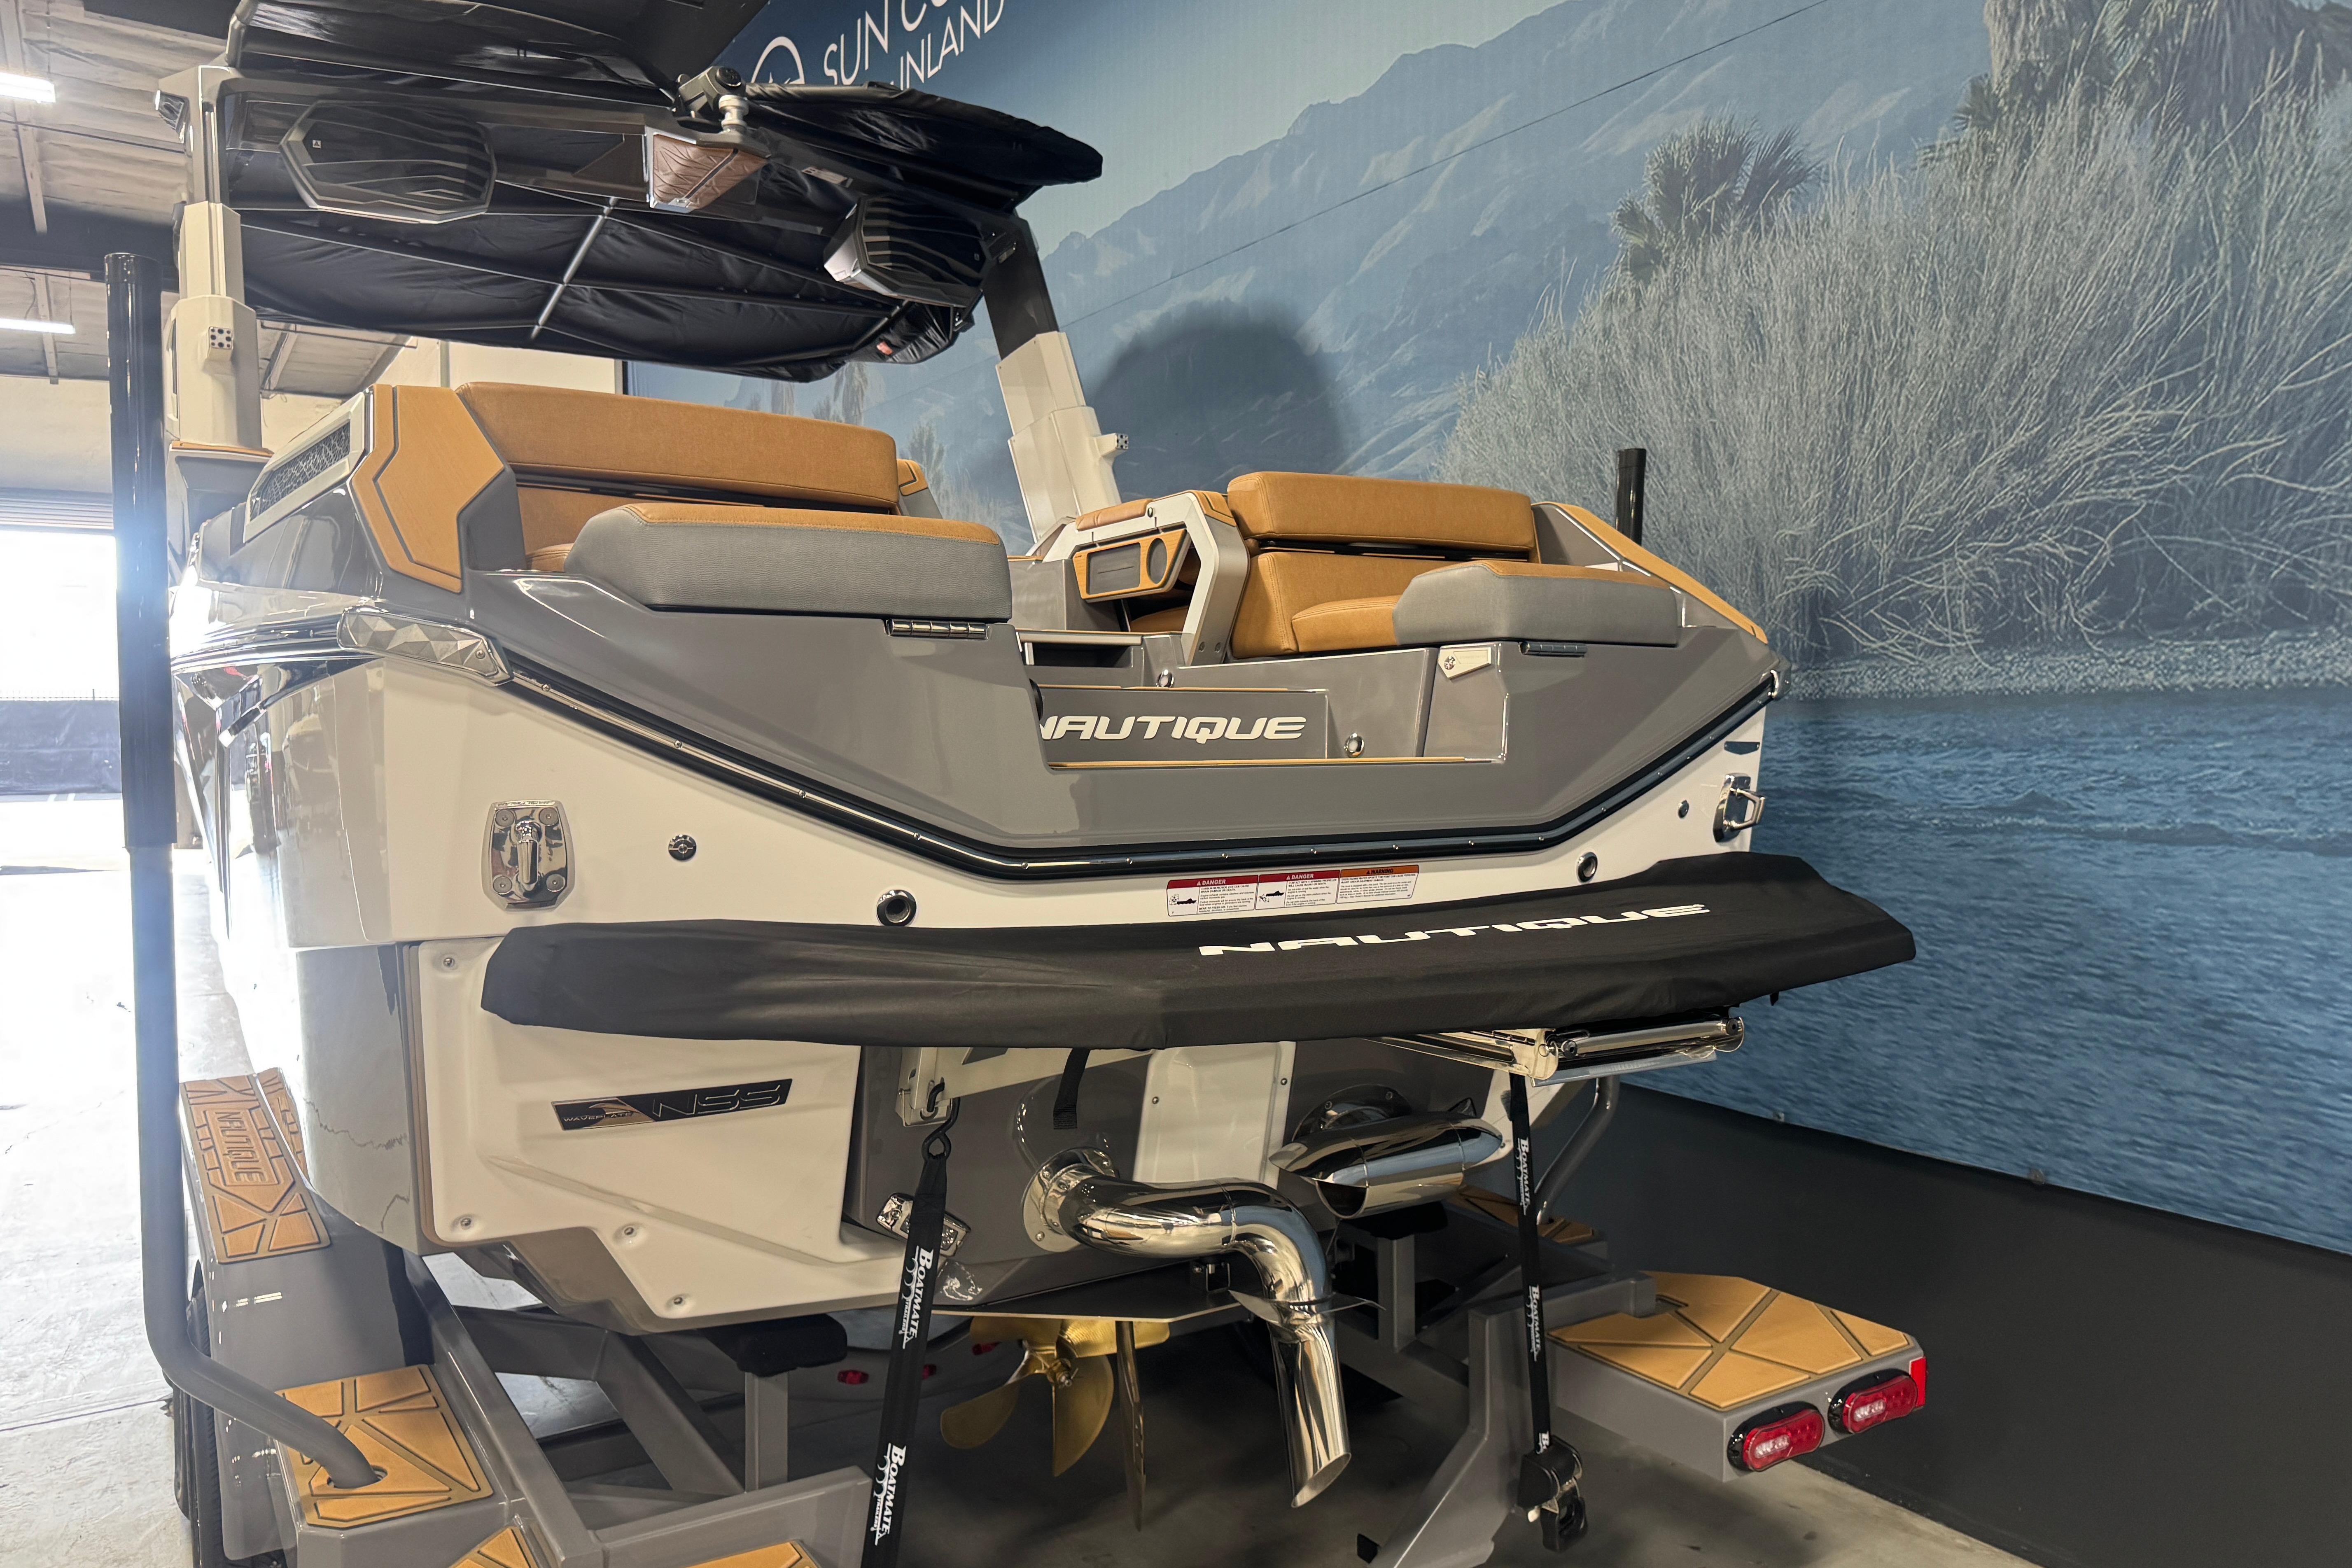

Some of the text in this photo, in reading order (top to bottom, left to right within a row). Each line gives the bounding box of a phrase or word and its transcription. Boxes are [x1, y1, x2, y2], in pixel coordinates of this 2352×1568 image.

[824, 0, 888, 85] SUN
[900, 0, 1004, 91] INLAND
[1199, 904, 1710, 956] NAUTIQUE
[652, 1084, 781, 1118] NSS
[215, 1111, 267, 1182] NAUTIQUE
[909, 1247, 934, 1338] BOATMATE
[882, 1445, 907, 1535] BOATMATE
